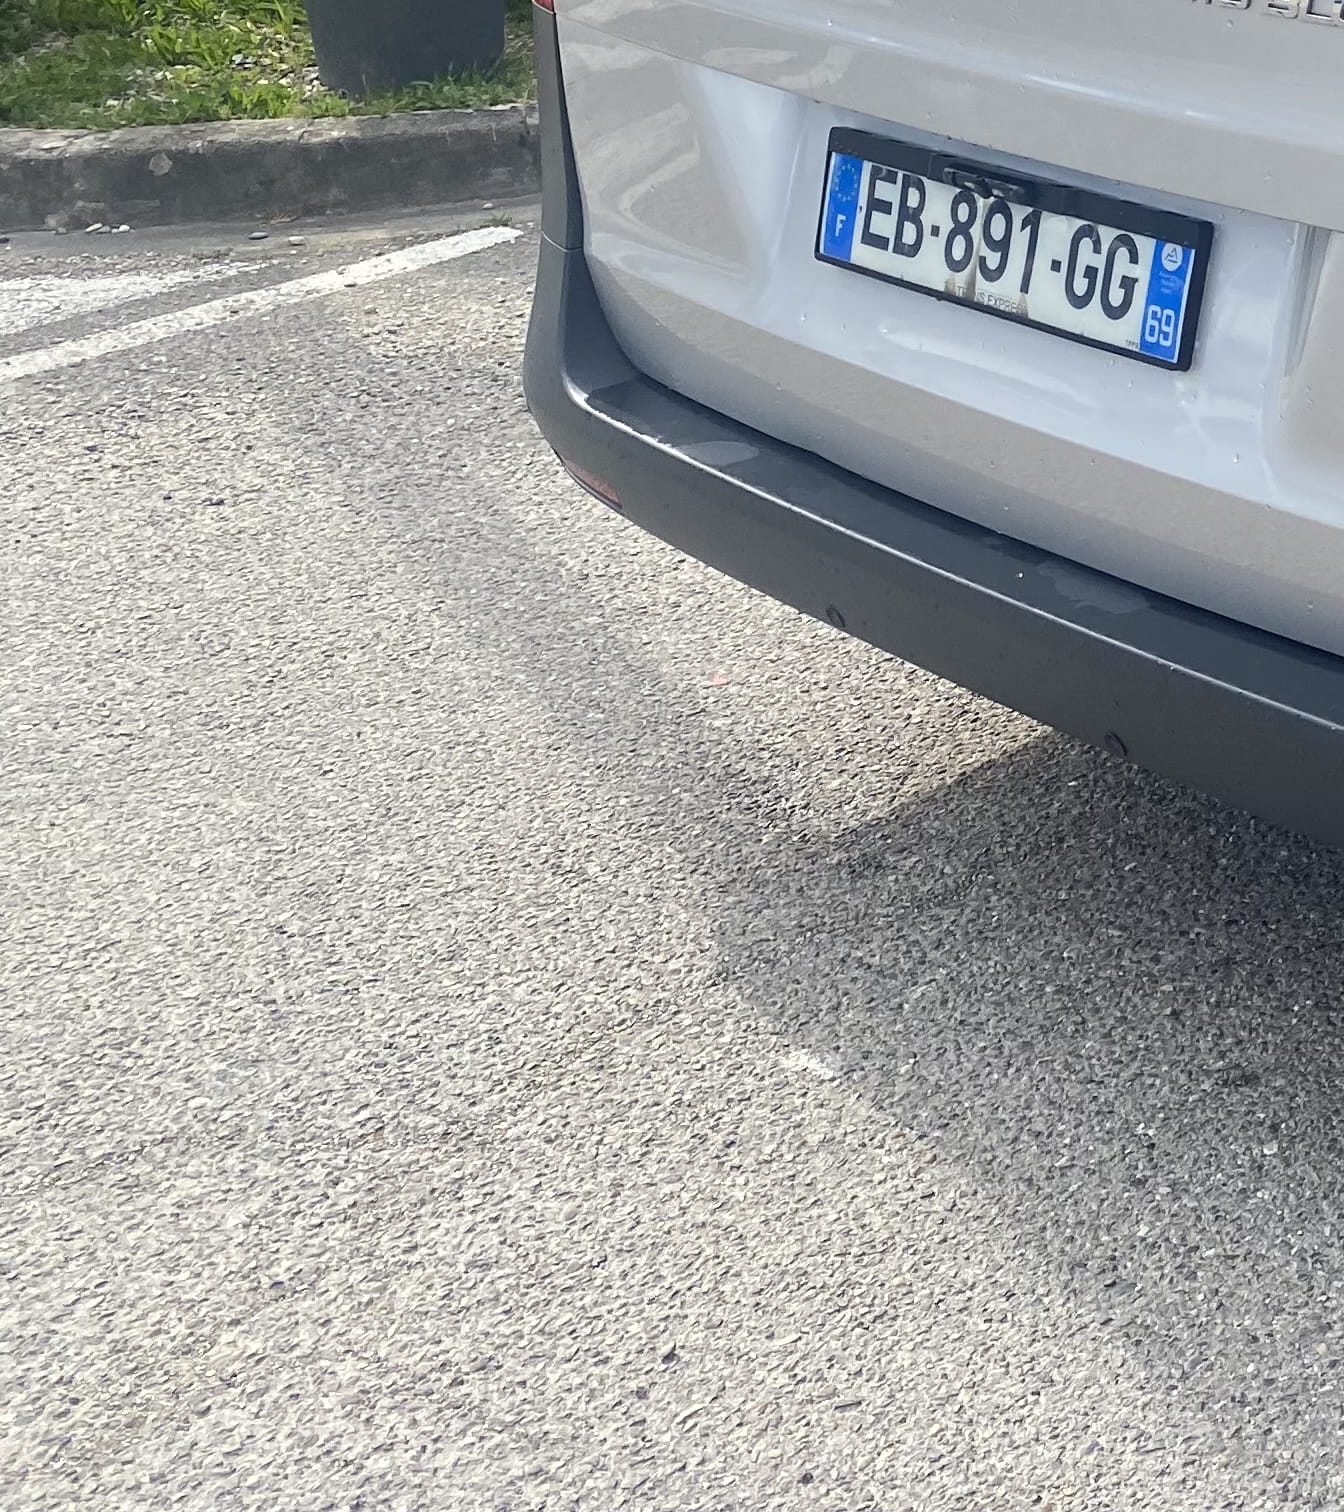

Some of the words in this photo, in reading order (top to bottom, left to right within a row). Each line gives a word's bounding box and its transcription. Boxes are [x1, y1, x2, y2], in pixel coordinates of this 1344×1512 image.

[834, 214, 846, 238] F
[860, 164, 1140, 321] EB-891-GG
[1144, 304, 1176, 348] 69
